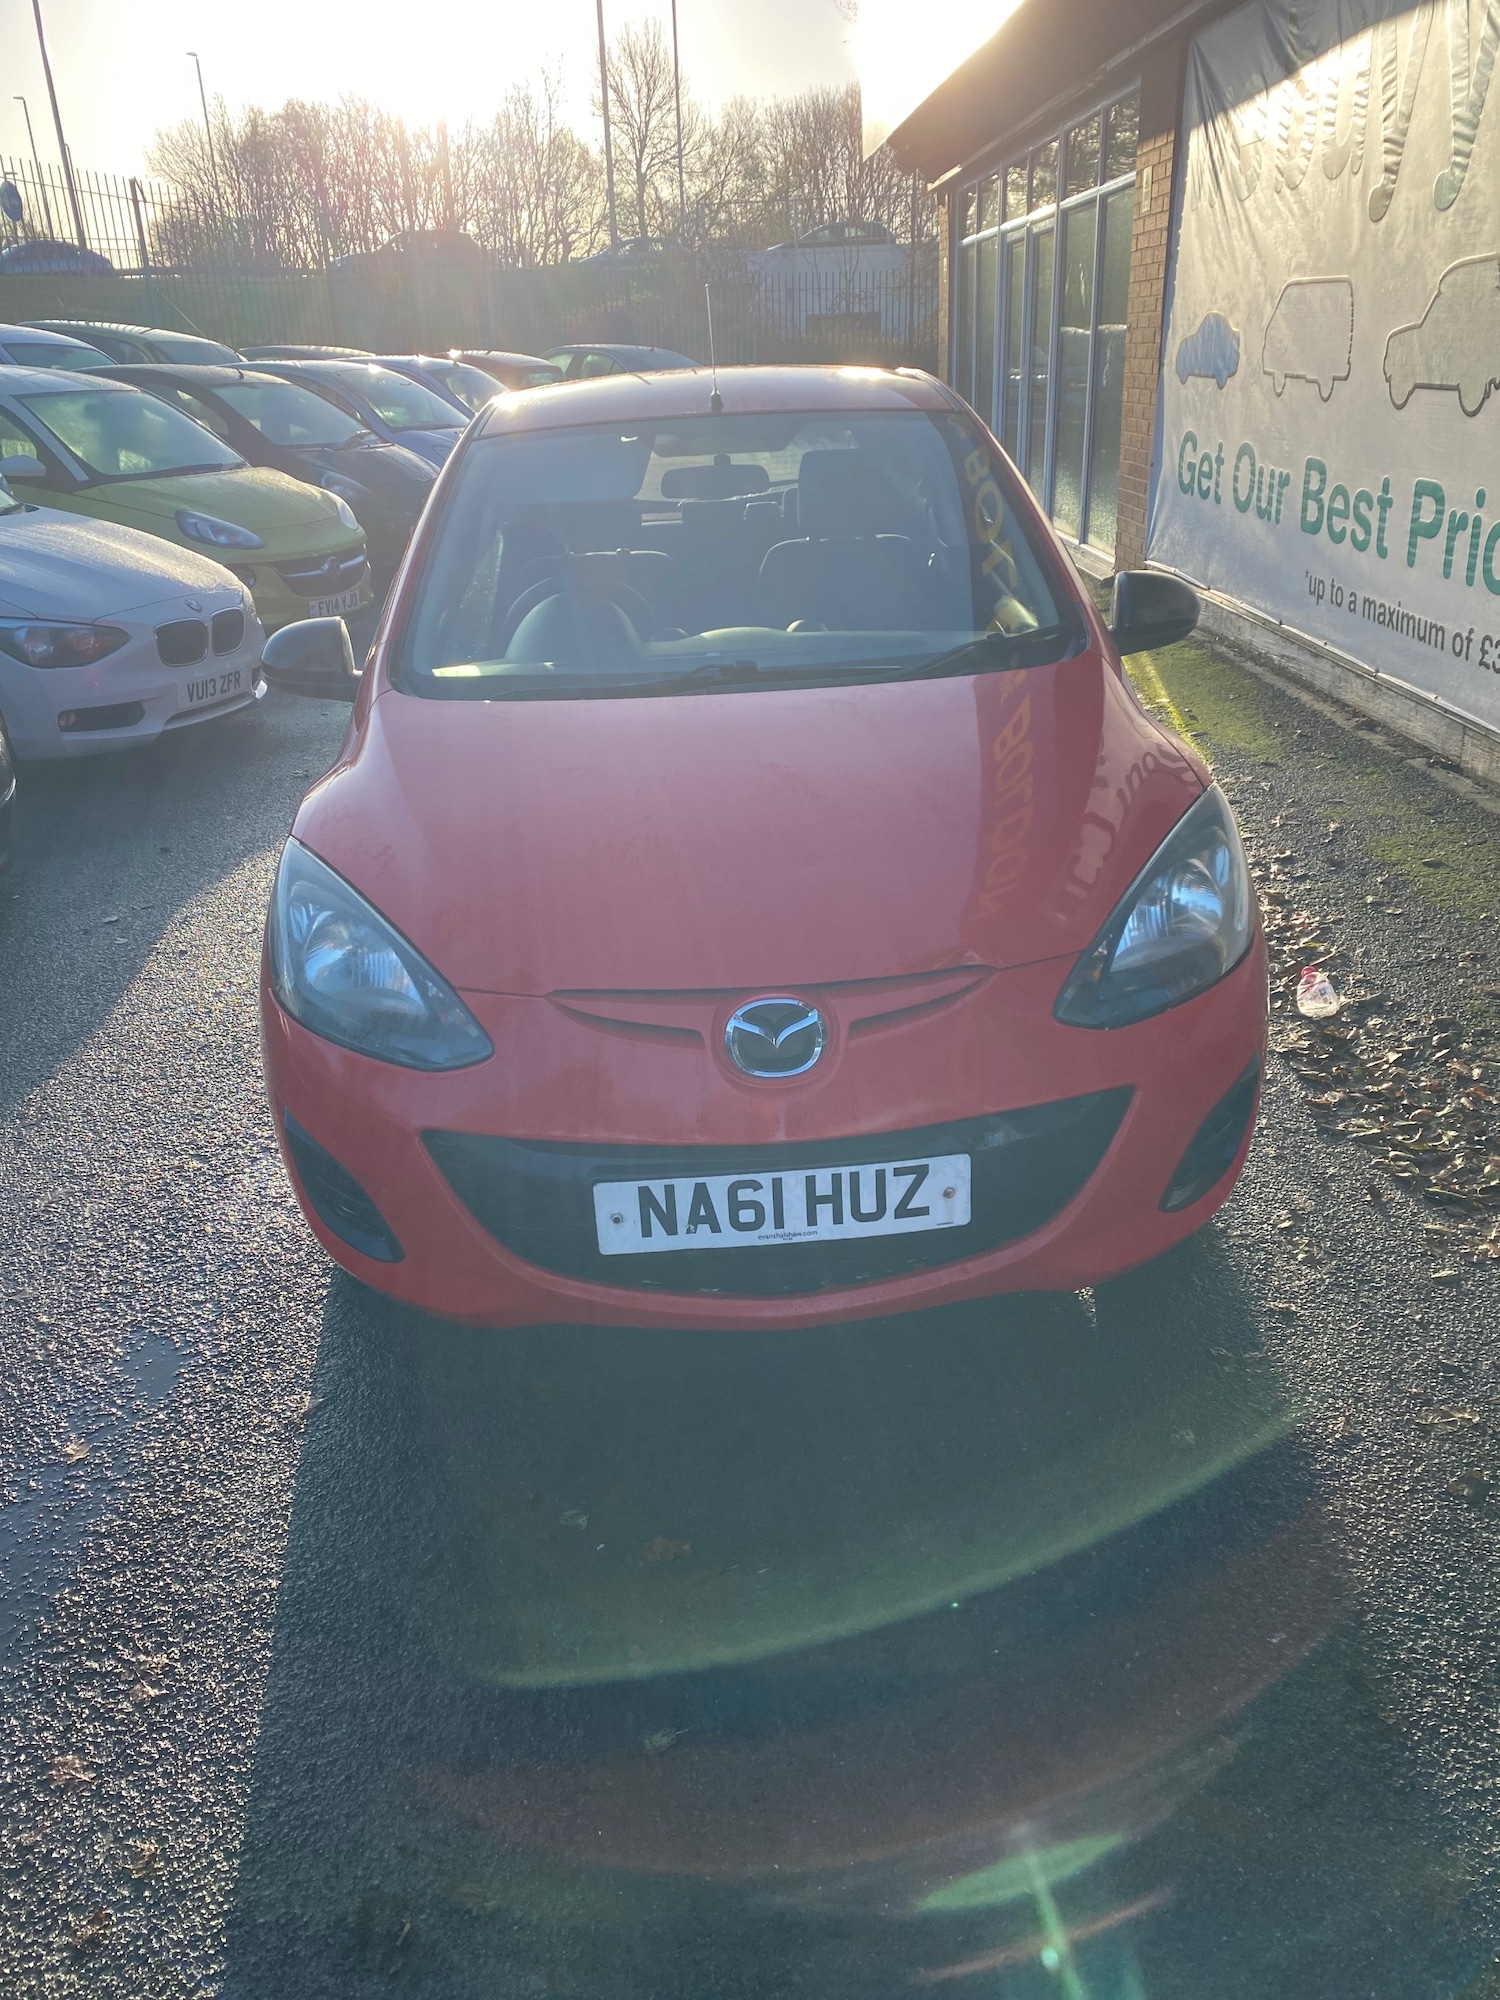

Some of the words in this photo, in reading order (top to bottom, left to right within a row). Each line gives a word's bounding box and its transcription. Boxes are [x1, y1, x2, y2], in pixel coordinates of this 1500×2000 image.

[1178, 430, 1225, 505] Get
[1233, 441, 1291, 525] Our
[1301, 456, 1394, 559] Best
[318, 598, 340, 616] FV14
[1330, 578, 1344, 608] to
[1348, 591, 1357, 614] a
[1362, 595, 1445, 651] maximum
[1452, 627, 1475, 661] of
[186, 678, 217, 703] VU13
[219, 670, 241, 695] ZFR
[637, 1177, 785, 1238] NA61
[805, 1164, 931, 1227] HUZ
